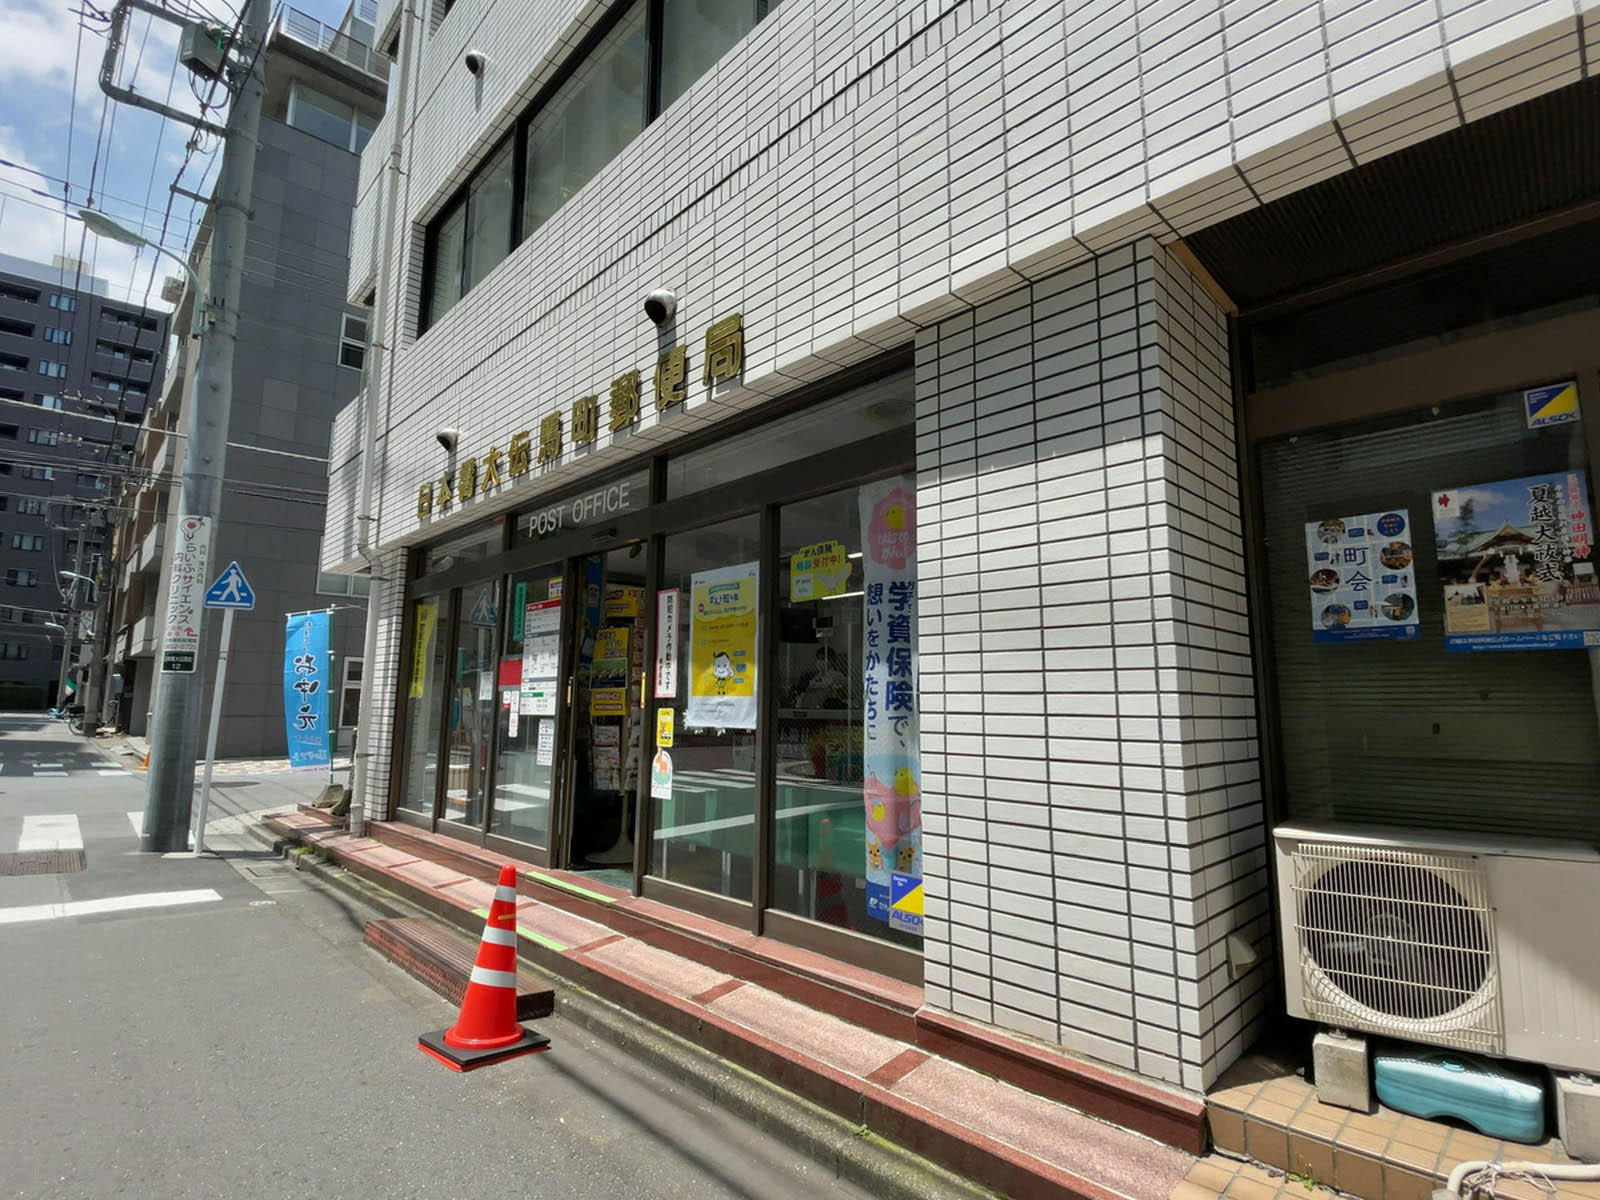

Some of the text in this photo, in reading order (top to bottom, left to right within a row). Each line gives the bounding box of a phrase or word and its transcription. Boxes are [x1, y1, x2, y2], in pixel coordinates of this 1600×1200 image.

[1531, 411, 1577, 426] ALSOK
[528, 482, 631, 538] POST OFFICE
[1528, 483, 1564, 583] 夏越大祓式
[1344, 546, 1373, 592] 町会
[865, 583, 884, 741] 想いをかたちに
